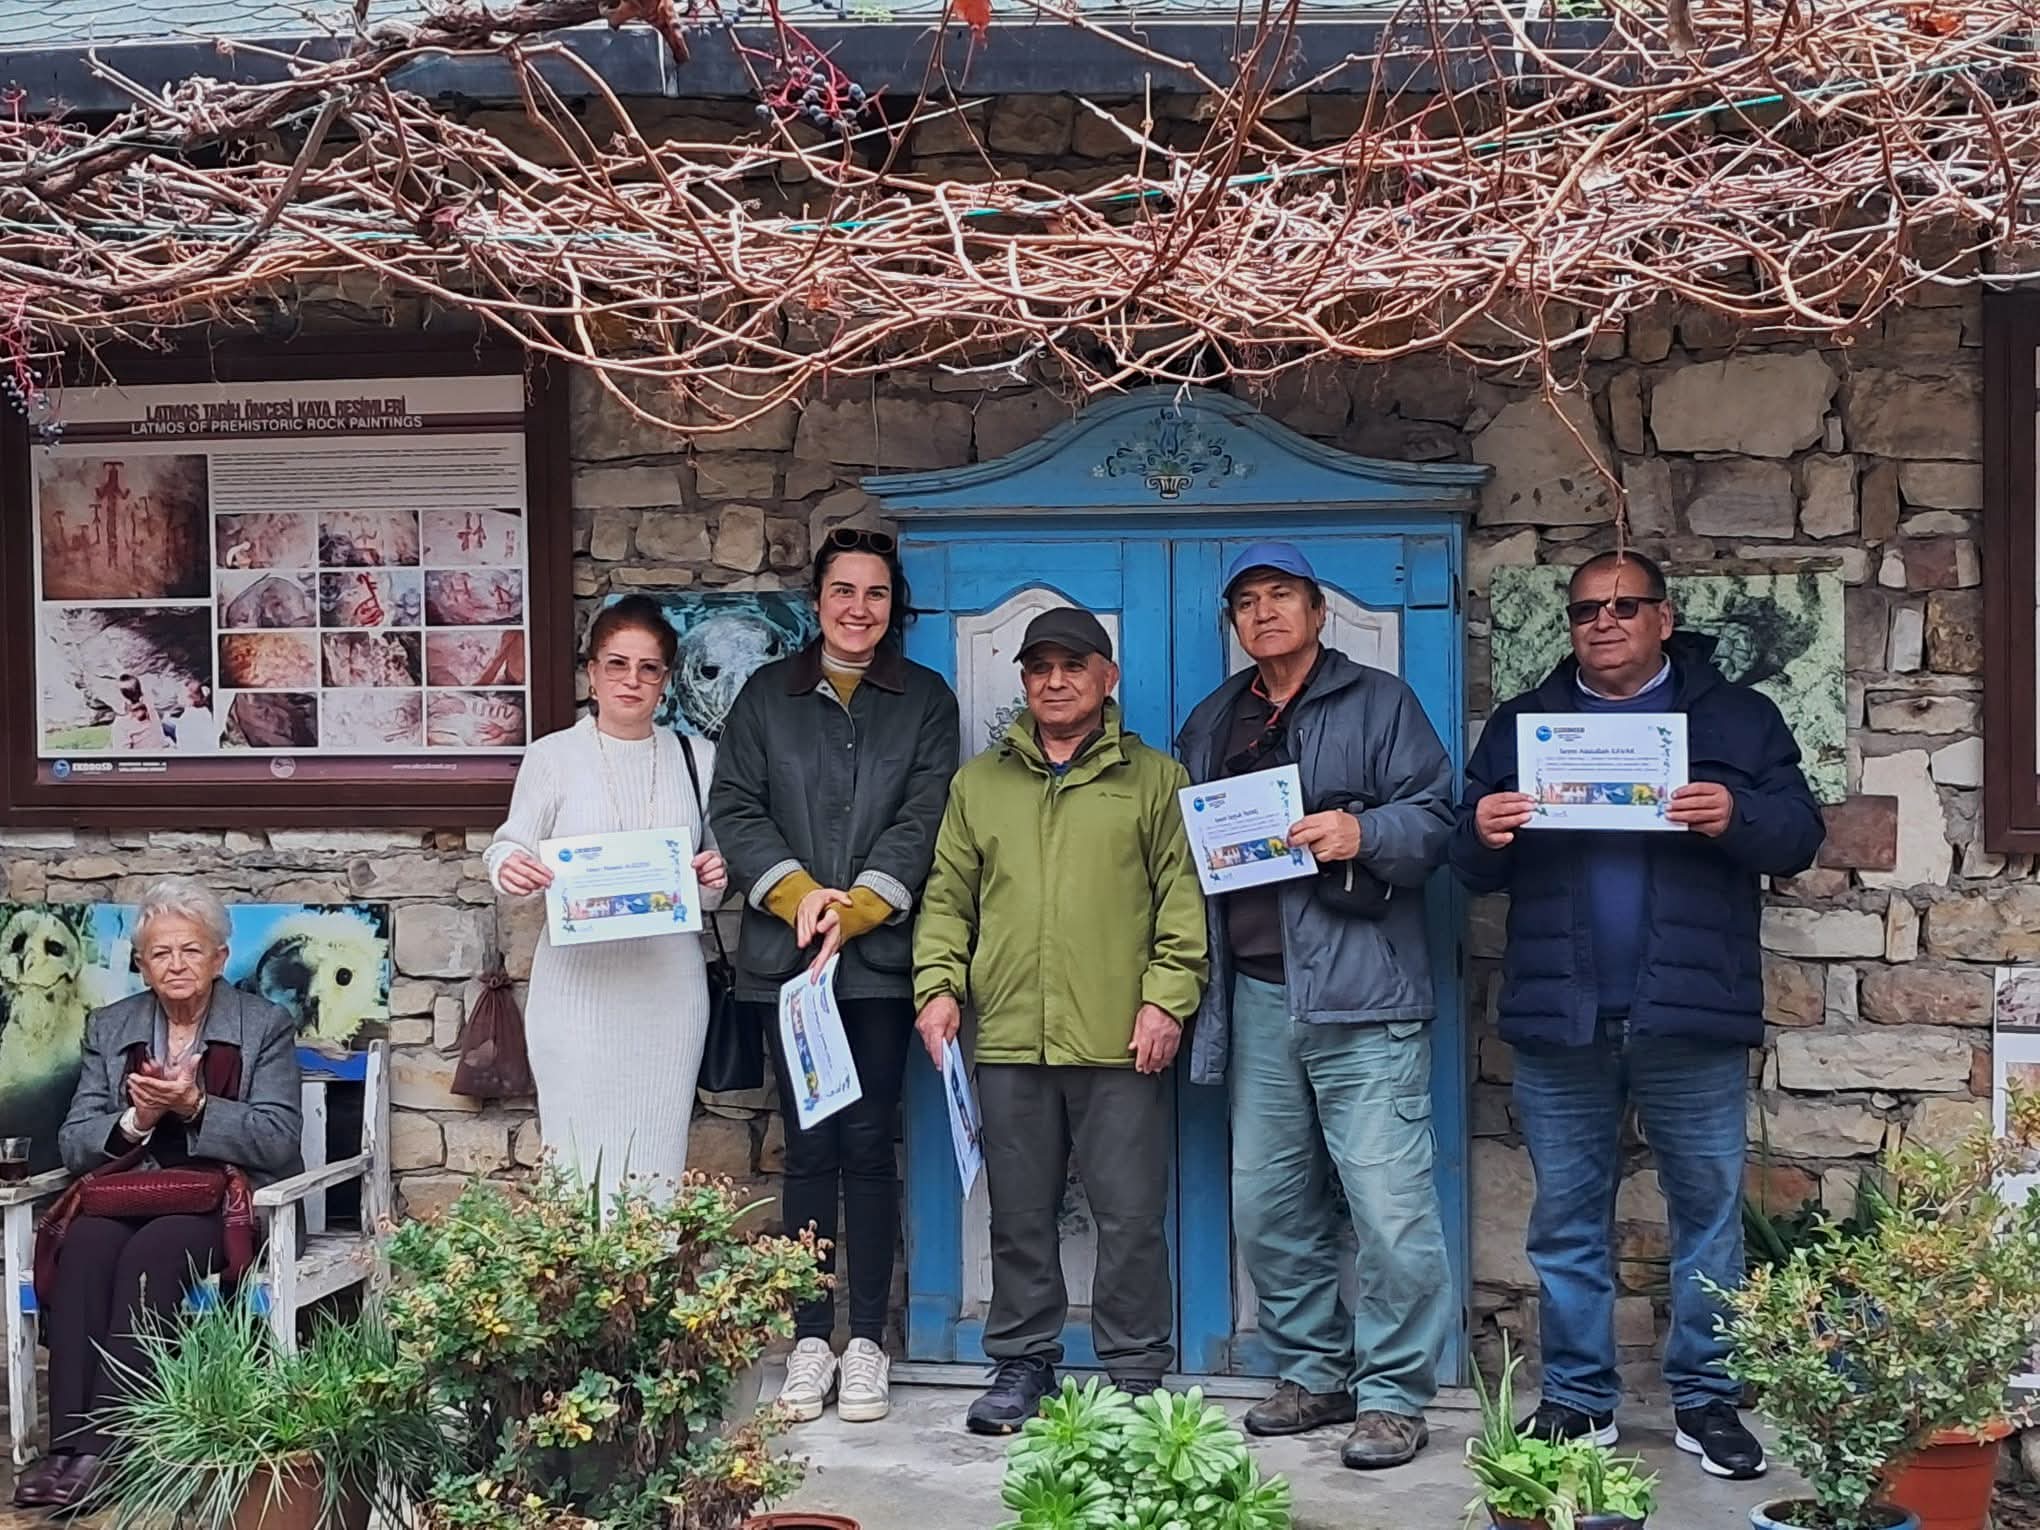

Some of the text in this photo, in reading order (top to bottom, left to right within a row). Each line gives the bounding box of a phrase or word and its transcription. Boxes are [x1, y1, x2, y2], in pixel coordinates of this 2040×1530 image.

[145, 403, 200, 421] LATMOS
[245, 398, 293, 419] ÖNCESİ
[298, 399, 332, 418] KAYA
[335, 395, 406, 417] RESİMLERİ
[131, 415, 423, 435] LATMOS OF PREHISTORIC ROCK PAINTINGS
